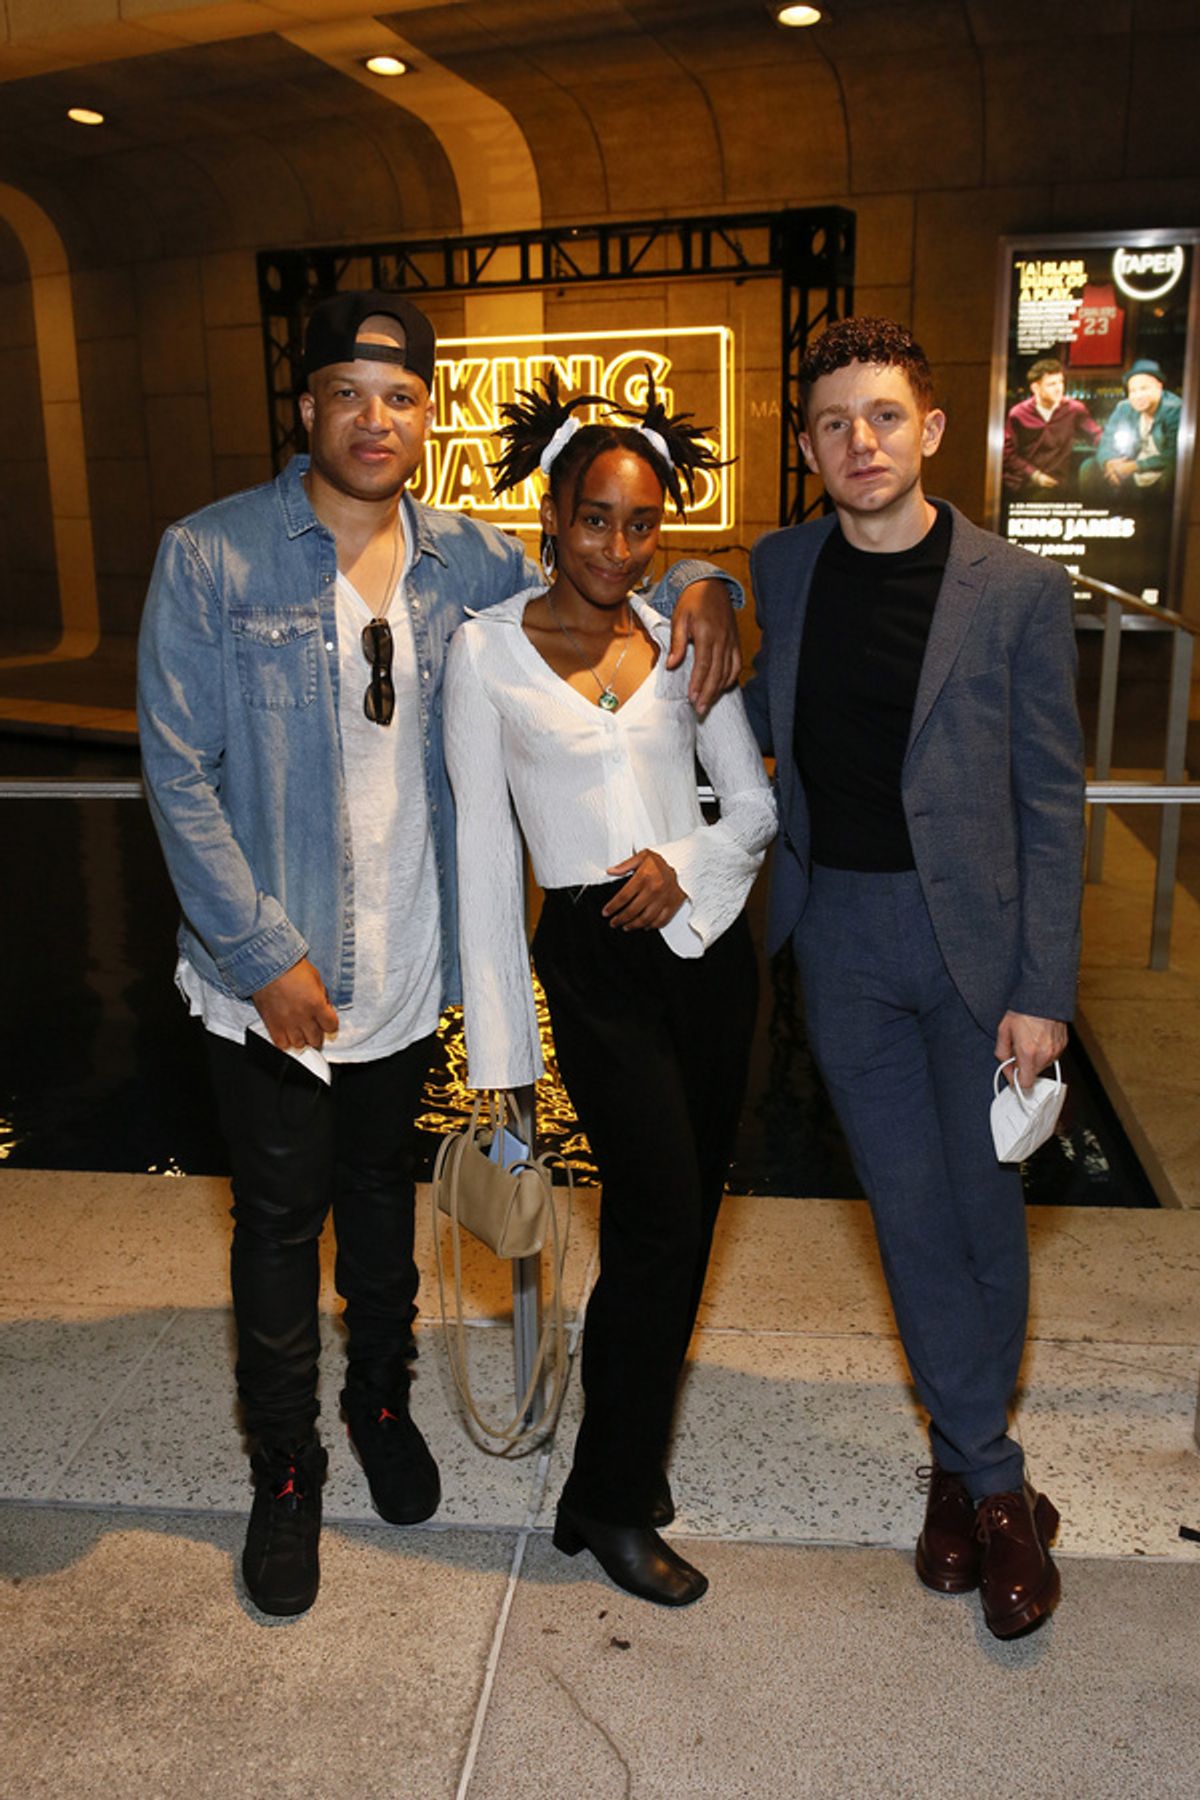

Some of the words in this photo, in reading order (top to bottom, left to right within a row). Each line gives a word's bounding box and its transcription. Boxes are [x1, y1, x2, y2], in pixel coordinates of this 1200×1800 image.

[1118, 253, 1180, 274] TAPER
[1066, 274, 1087, 287] OF
[1084, 317, 1109, 335] 23
[432, 350, 673, 432] KING
[1008, 518, 1063, 537] KING
